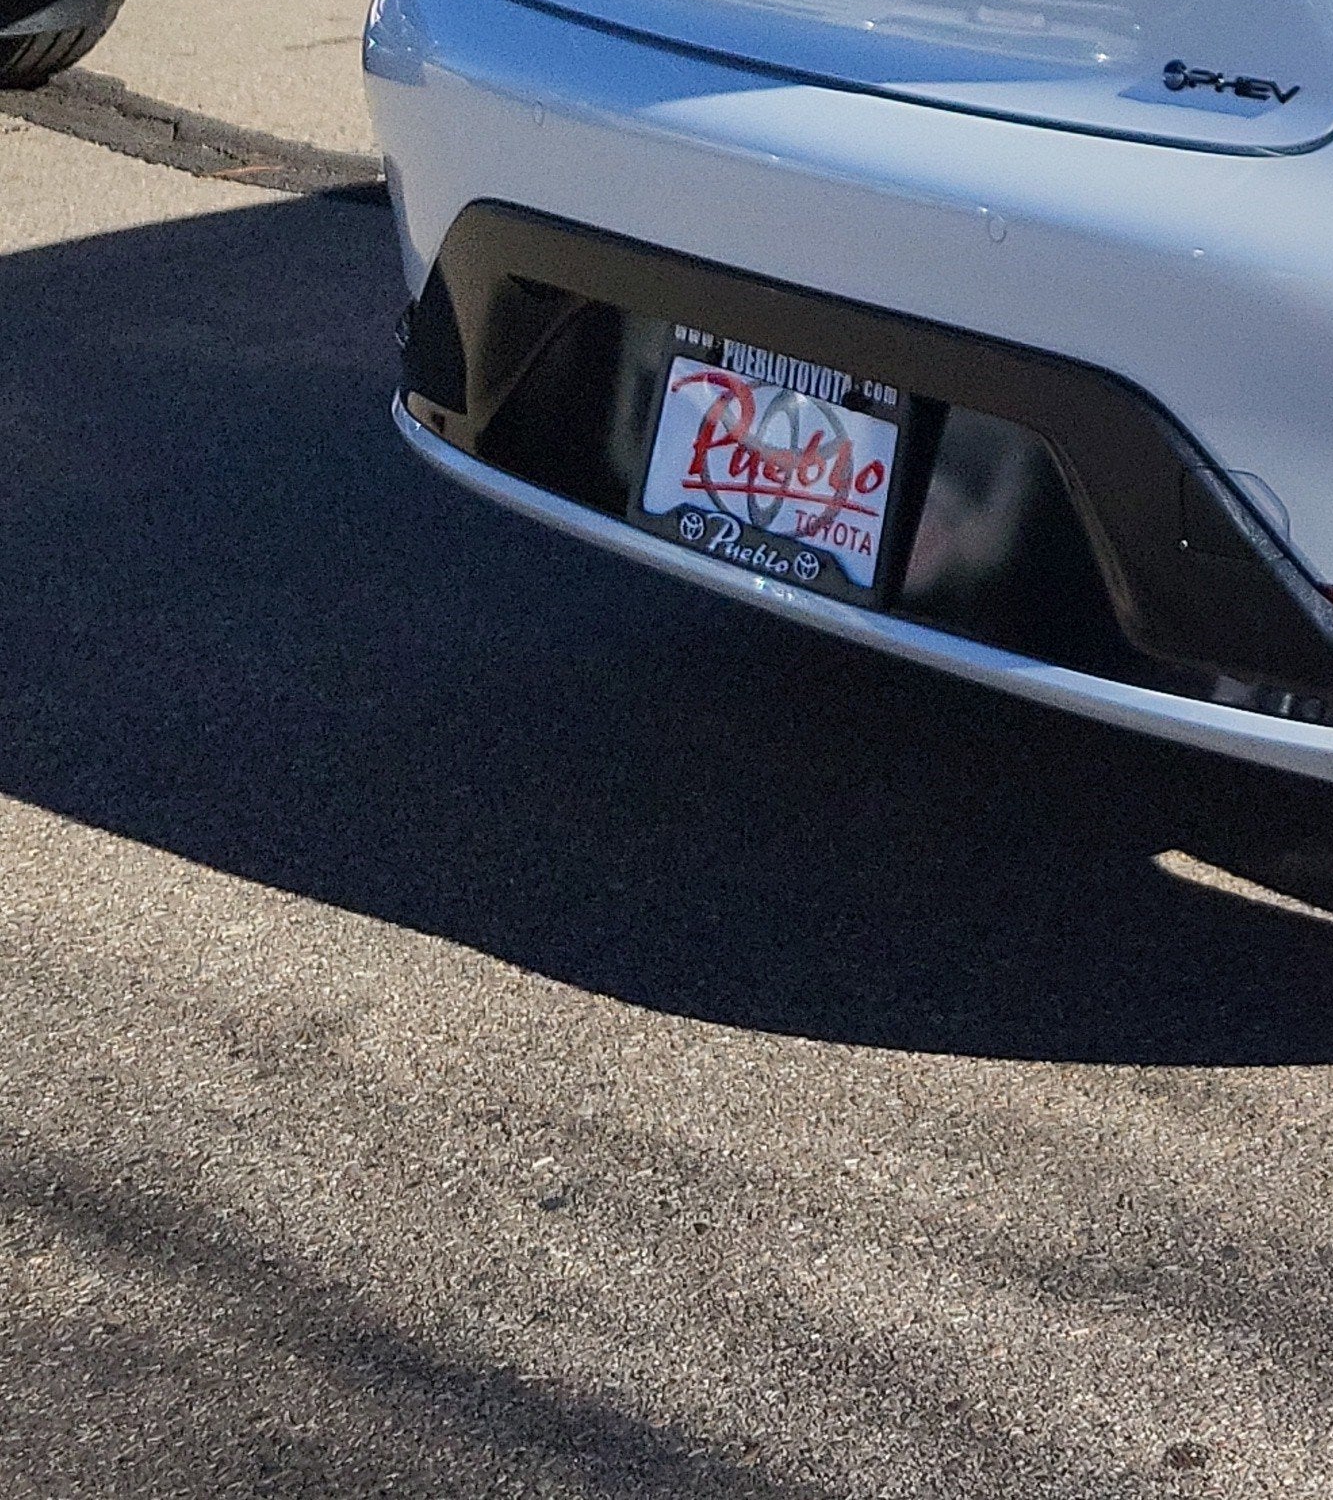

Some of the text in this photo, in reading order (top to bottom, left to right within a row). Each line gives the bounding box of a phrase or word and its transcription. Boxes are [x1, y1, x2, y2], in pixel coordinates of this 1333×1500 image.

[1187, 68, 1301, 104] PHEV
[671, 371, 885, 494] Pueblo
[706, 512, 790, 574] Pueblo
[795, 509, 873, 557] TOYOTA
